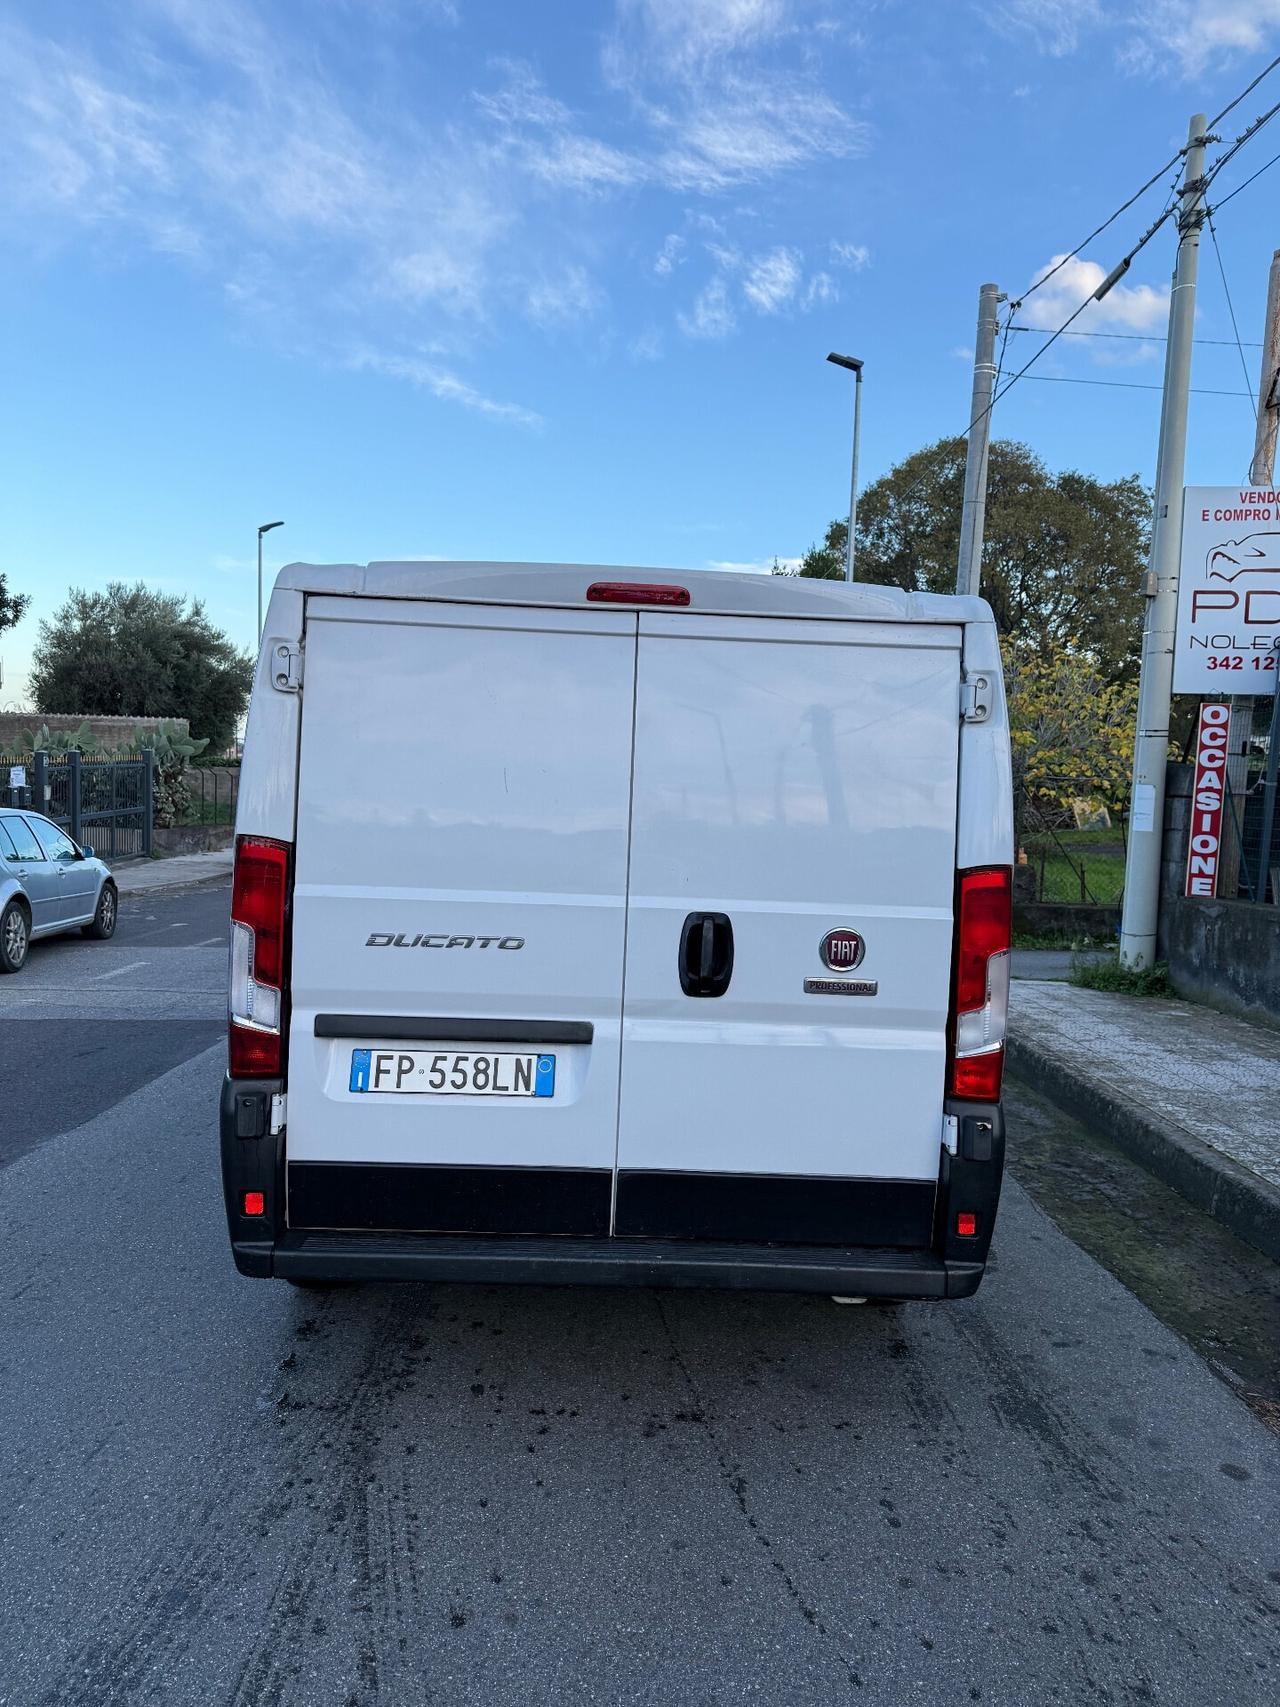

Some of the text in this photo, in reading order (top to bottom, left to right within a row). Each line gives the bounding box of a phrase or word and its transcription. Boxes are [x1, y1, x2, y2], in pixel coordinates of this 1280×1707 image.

[1201, 509, 1210, 521] E
[1214, 508, 1271, 521] COMPRO
[1206, 656, 1280, 670] 342 12
[1190, 705, 1229, 896] OCCASIONE
[365, 932, 525, 950] DUCATO
[830, 940, 857, 961] FIAT
[808, 981, 873, 992] PROFESSIONAL
